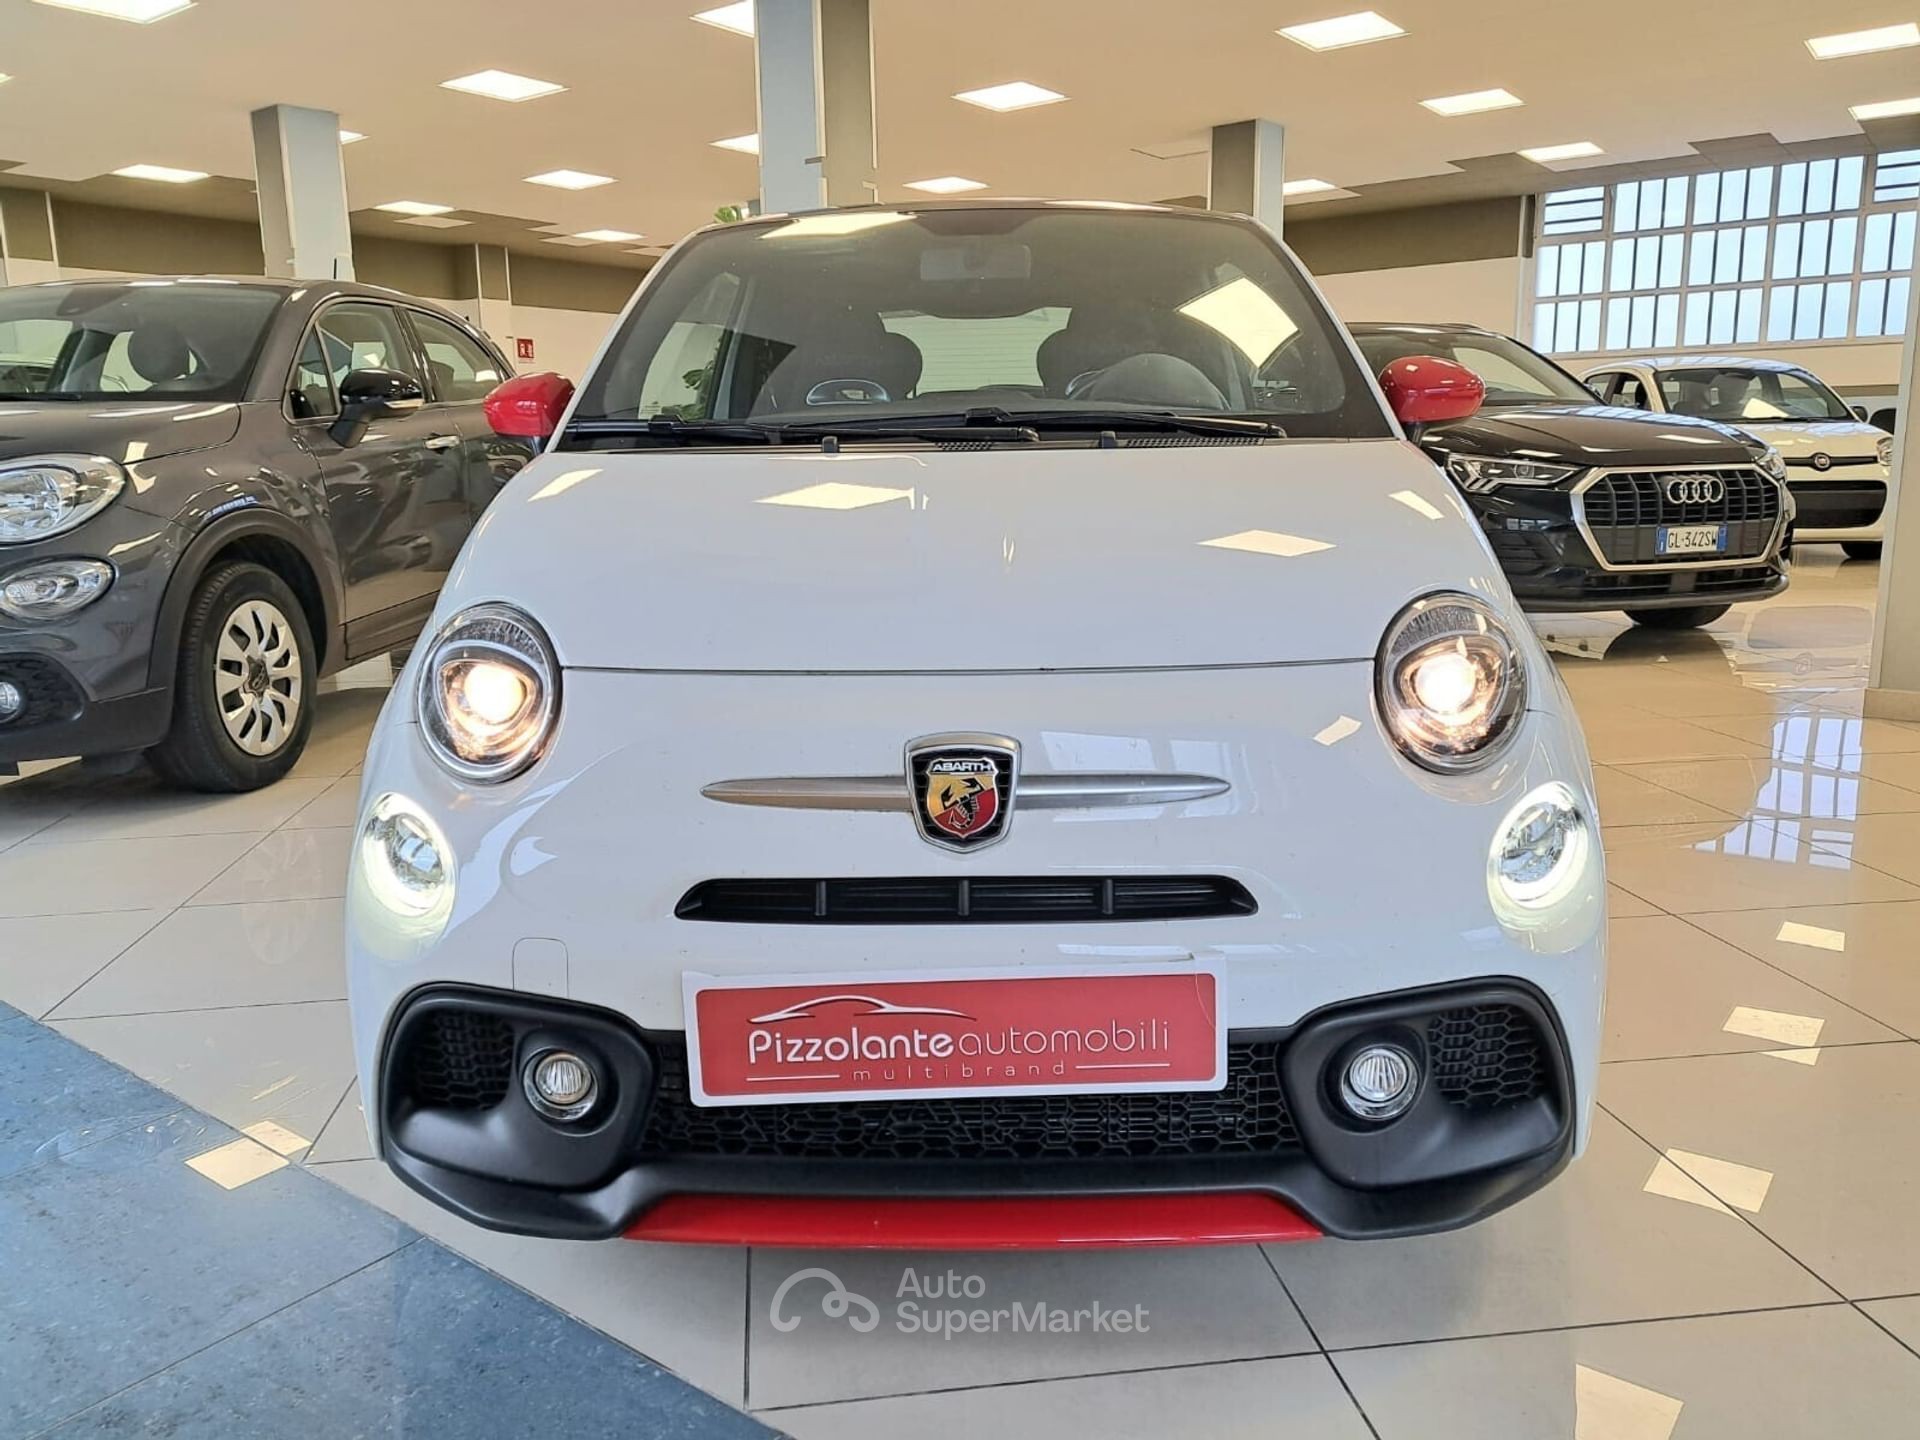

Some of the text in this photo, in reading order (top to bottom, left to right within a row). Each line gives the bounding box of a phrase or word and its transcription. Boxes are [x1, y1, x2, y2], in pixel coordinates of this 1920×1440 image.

[933, 763, 991, 772] ABARTH
[748, 1019, 1169, 1064] Pizzolante automobili
[853, 1060, 1065, 1082] multibrand
